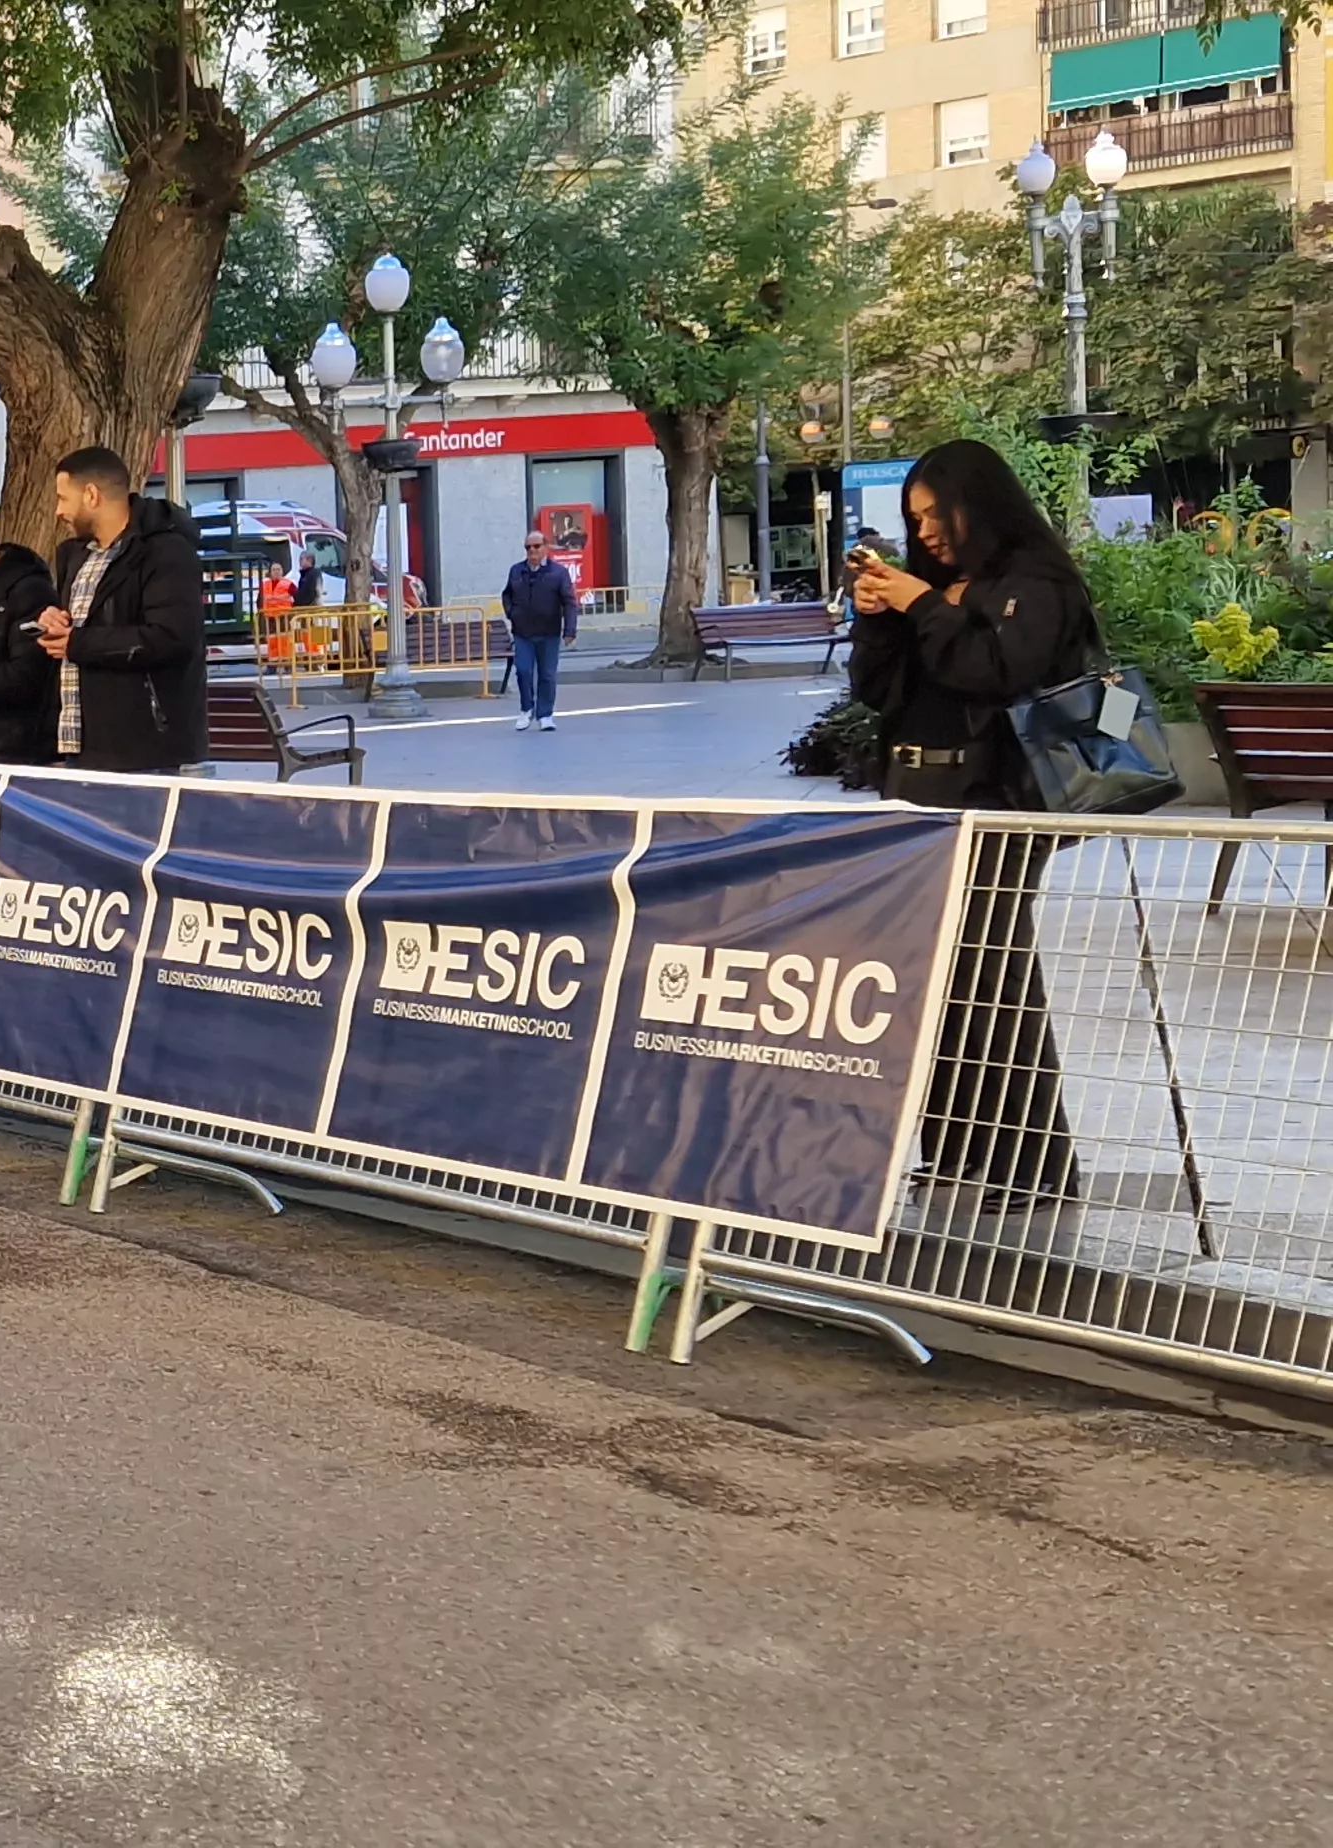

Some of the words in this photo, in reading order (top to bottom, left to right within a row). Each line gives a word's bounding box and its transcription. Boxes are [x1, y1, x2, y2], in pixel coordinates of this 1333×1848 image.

[22, 882, 130, 953] ESIC
[205, 902, 333, 981] ESIC
[429, 924, 585, 1011] ESIC
[700, 947, 897, 1046] ESIC
